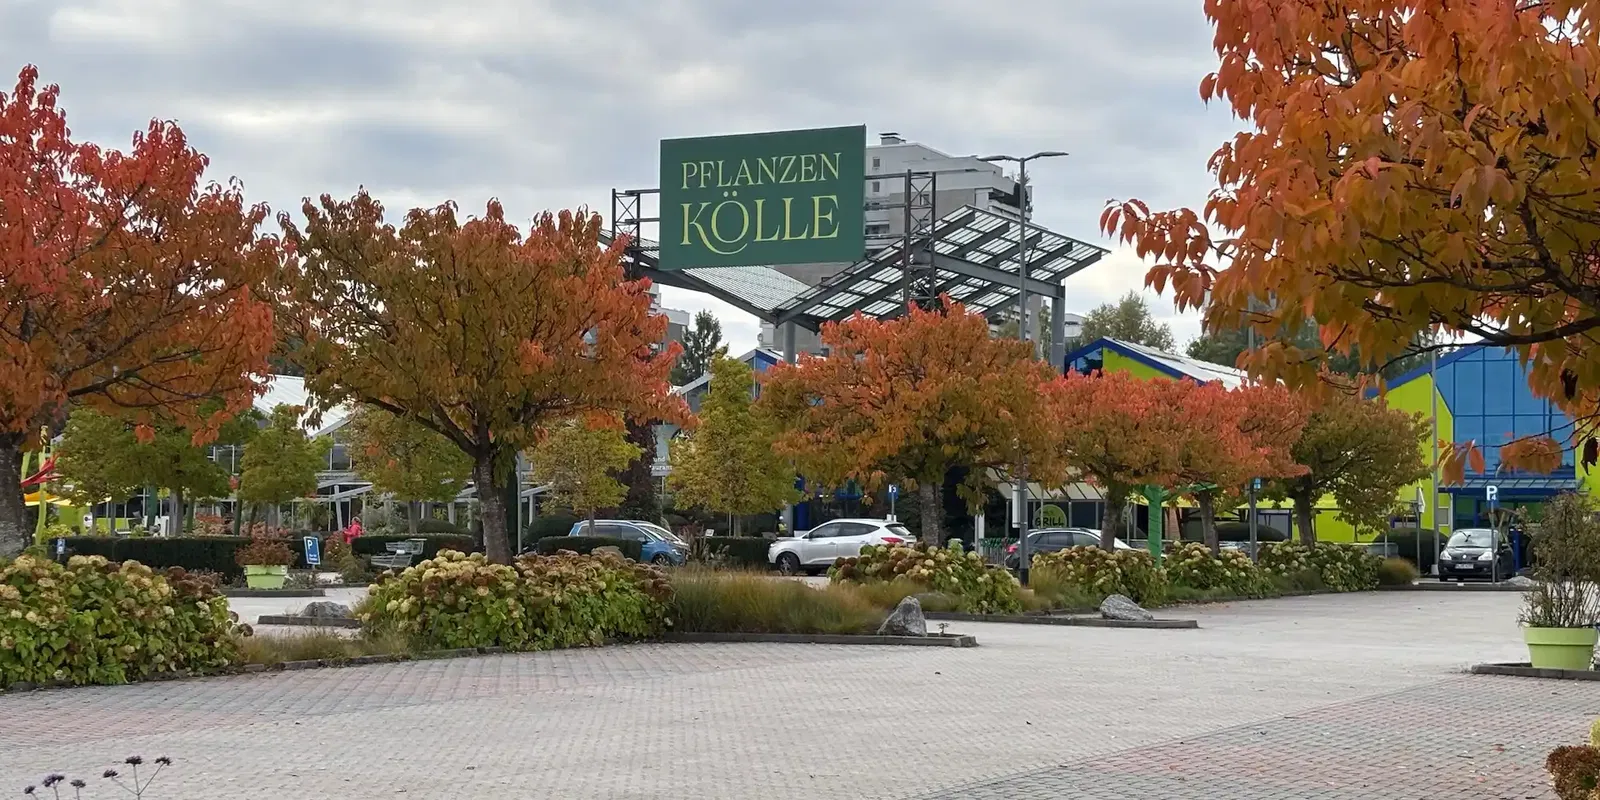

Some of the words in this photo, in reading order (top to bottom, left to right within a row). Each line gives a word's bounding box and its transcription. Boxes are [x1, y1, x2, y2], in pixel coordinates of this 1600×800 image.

[681, 152, 842, 190] PFLANZEN
[680, 190, 840, 255] KÖLLE
[1034, 516, 1065, 527] GRILL
[307, 539, 313, 550] P
